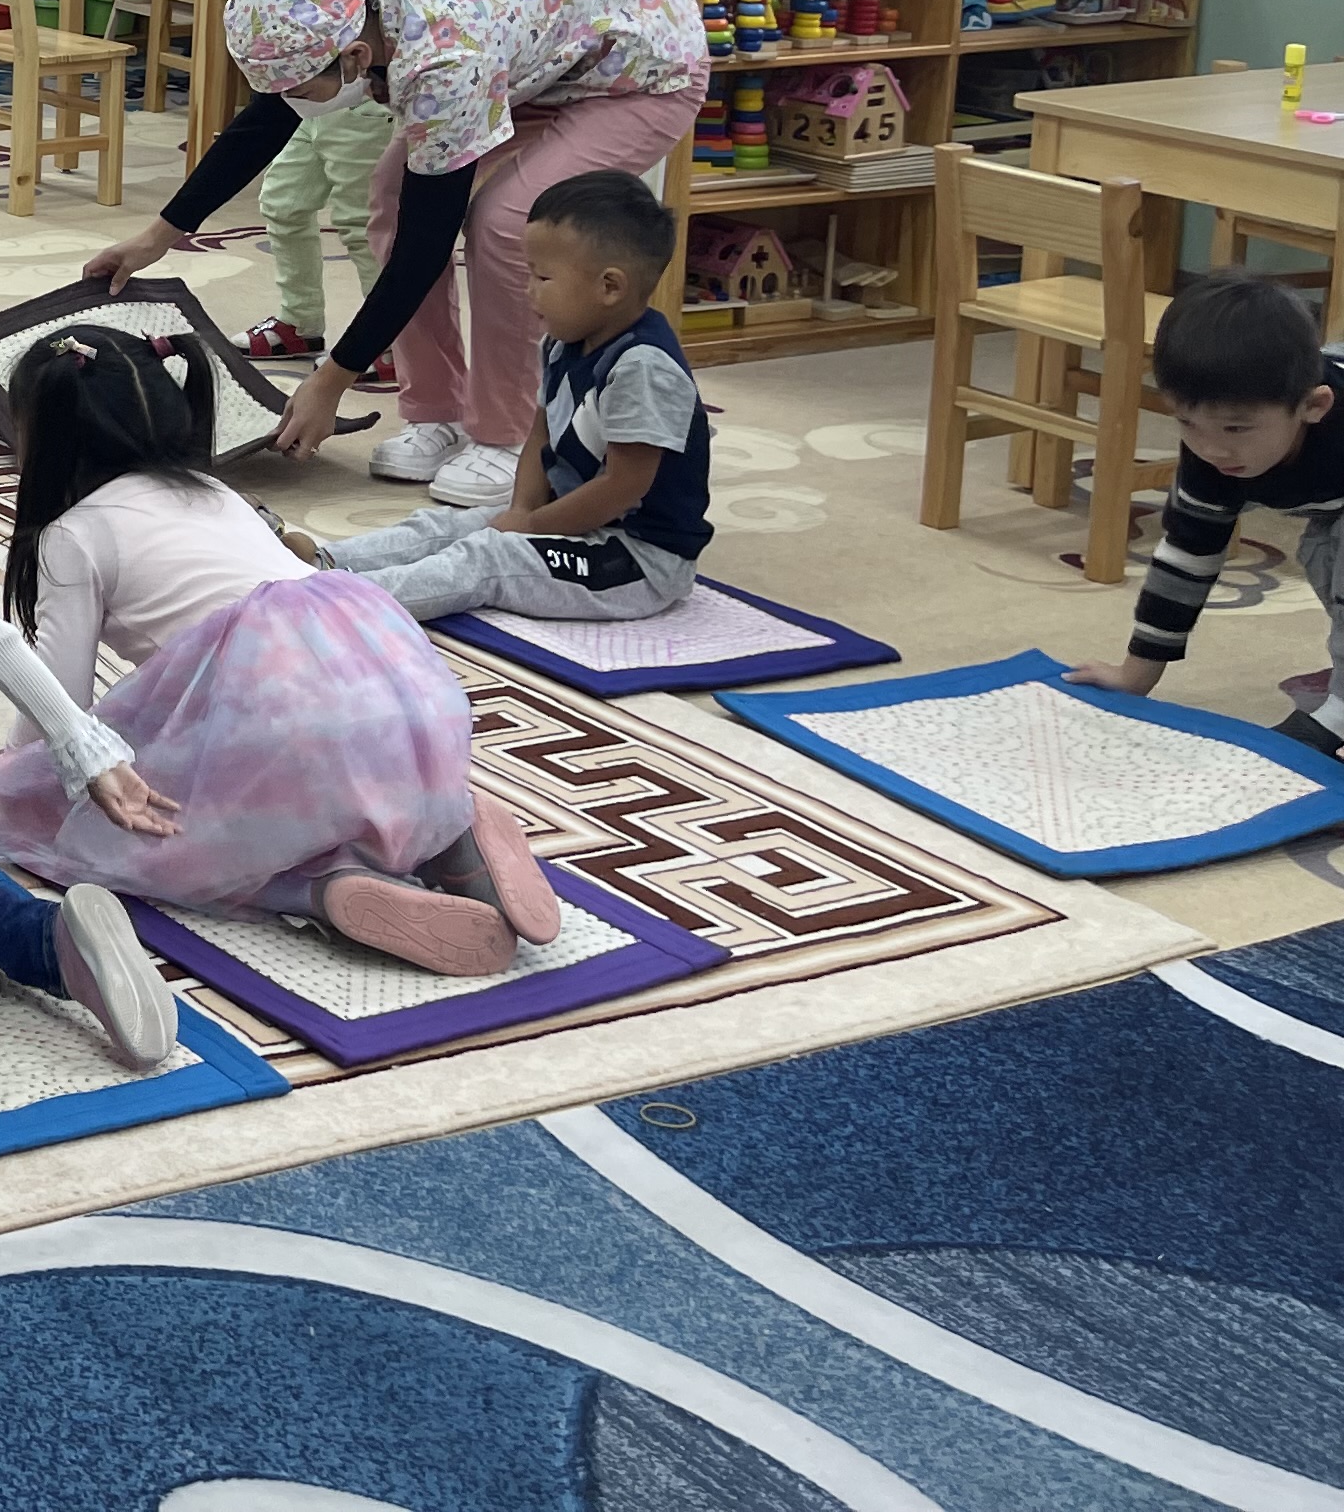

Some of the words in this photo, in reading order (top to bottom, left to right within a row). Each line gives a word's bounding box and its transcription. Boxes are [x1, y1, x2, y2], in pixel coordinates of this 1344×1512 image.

[792, 112, 810, 142] 2
[817, 118, 837, 146] 3
[853, 117, 871, 144] 4
[878, 111, 896, 142] 5
